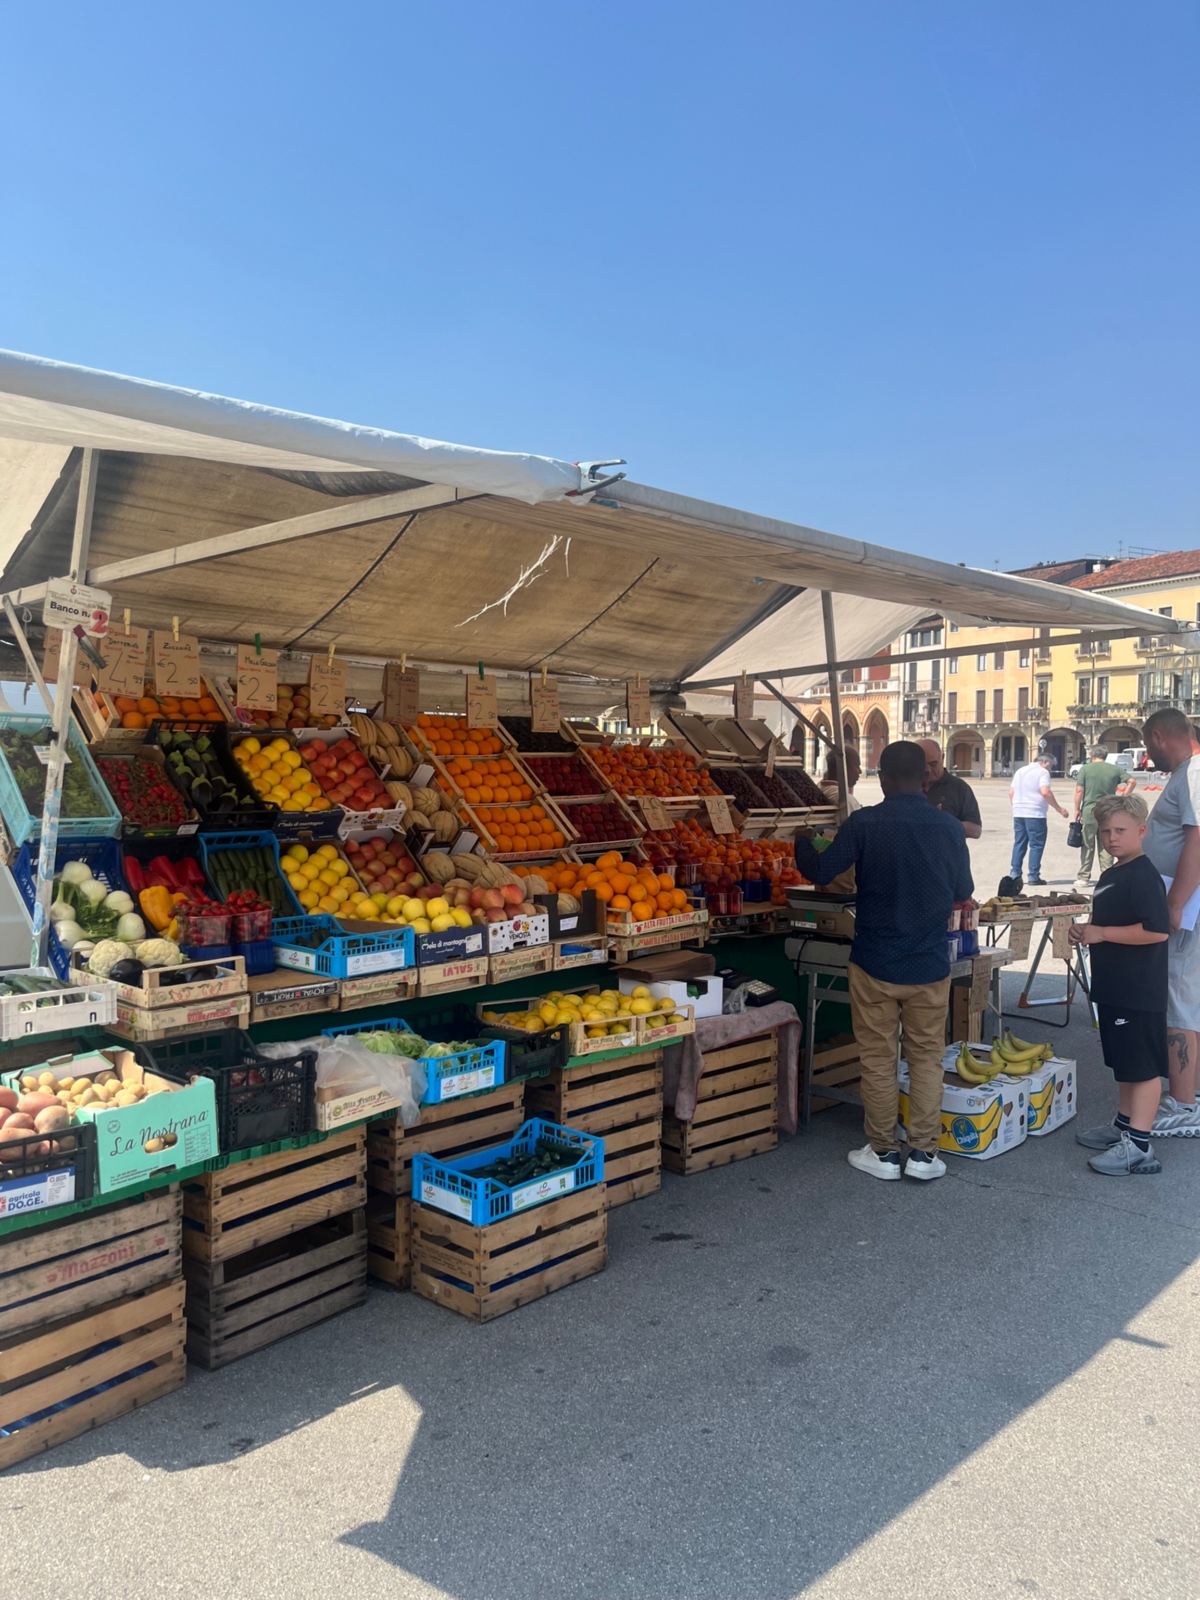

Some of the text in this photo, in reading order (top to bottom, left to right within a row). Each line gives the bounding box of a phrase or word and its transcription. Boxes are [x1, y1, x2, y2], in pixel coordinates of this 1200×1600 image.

[50, 601, 79, 615] Banco
[92, 610, 109, 634] 2
[109, 650, 127, 688] 4
[166, 662, 179, 683] 2
[247, 677, 260, 701] 2
[266, 694, 275, 703] 50
[317, 685, 329, 707] 2
[475, 702, 483, 720] 2
[539, 701, 548, 721] 2
[643, 919, 656, 929] ALTA
[657, 916, 675, 926] FRUTTA
[509, 931, 531, 940] VENOSTA
[443, 964, 473, 977] SALVI
[273, 987, 325, 1000] ROYAL FRUIT
[110, 1136, 136, 1156] La
[139, 1110, 208, 1146] Nostrana
[956, 1131, 979, 1145] Chiquita
[8, 1190, 41, 1203] agricola
[8, 1196, 44, 1212] DO.GE.
[59, 1241, 136, 1281] Mazzoni
